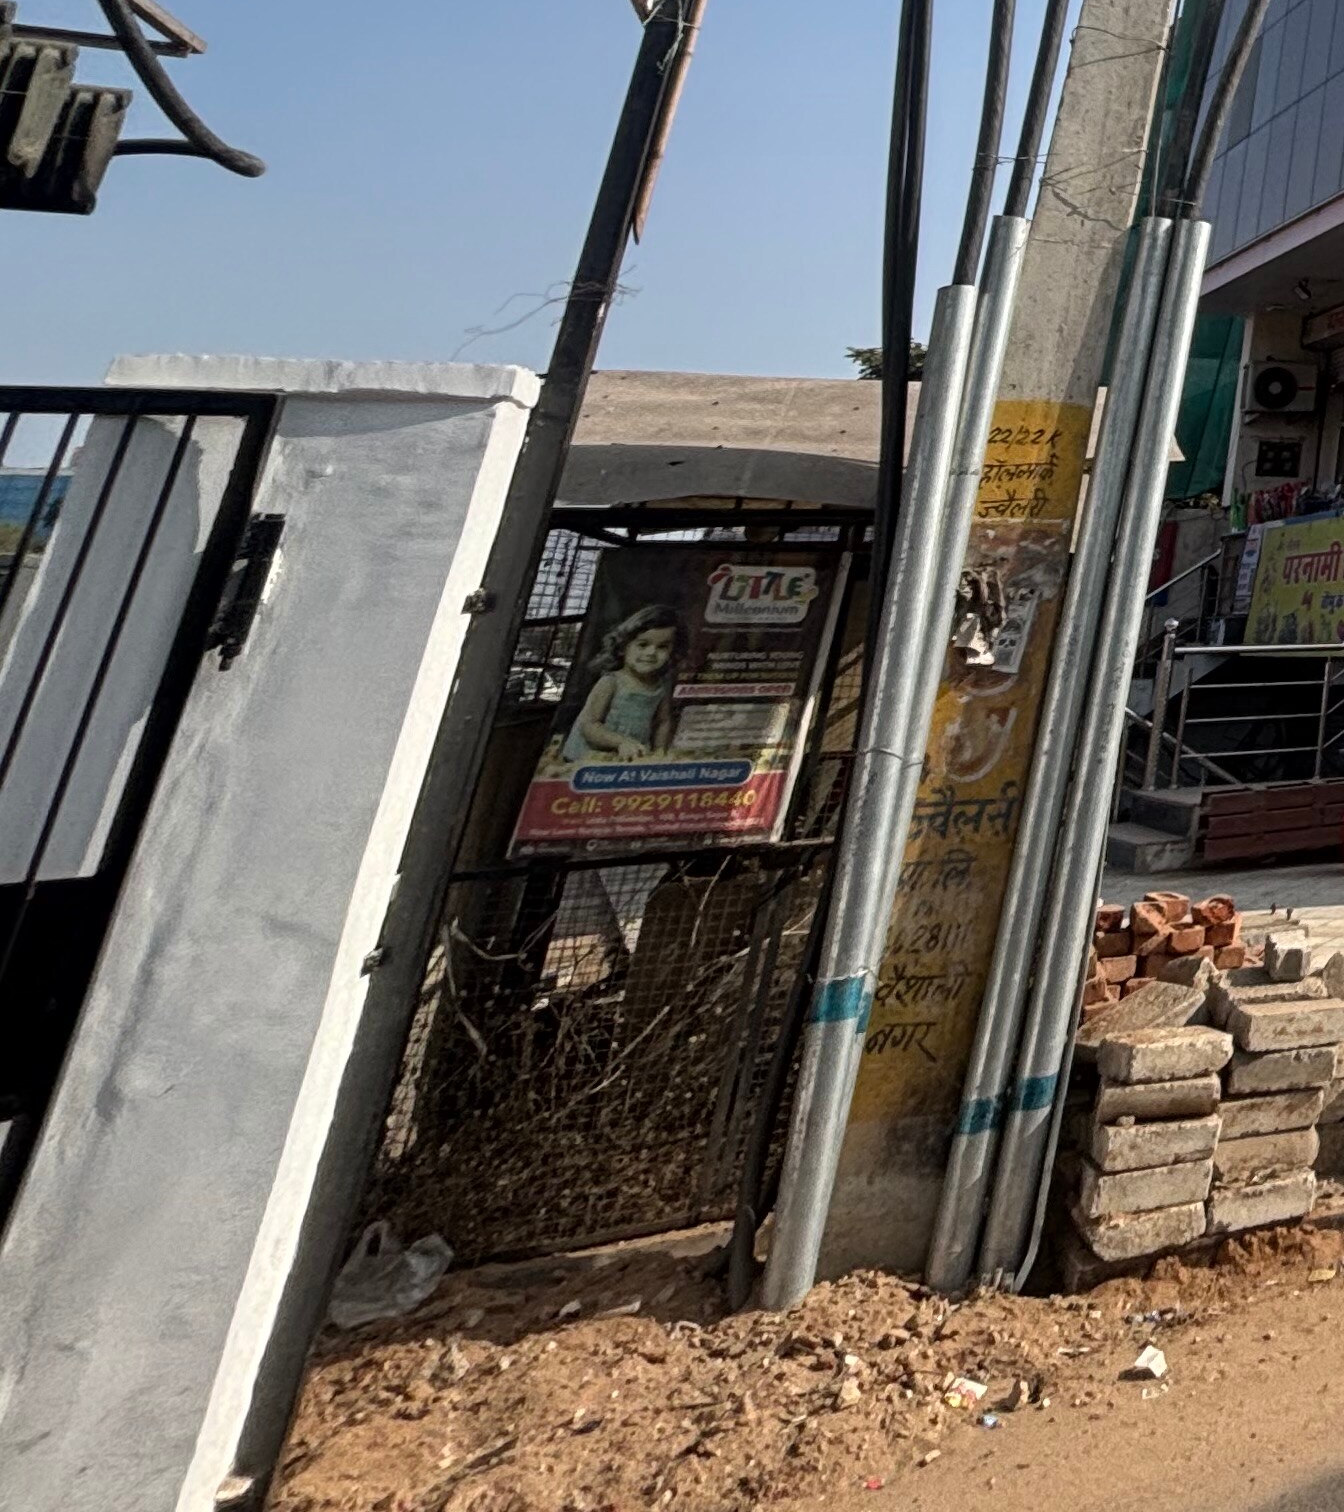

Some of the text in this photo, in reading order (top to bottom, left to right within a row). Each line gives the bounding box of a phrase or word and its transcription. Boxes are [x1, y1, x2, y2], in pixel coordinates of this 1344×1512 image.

[1282, 541, 1342, 585] परनामी
[582, 771, 618, 784] Now
[639, 767, 697, 782] Vaishali
[699, 767, 743, 781] Nagar
[551, 796, 601, 815] Call:
[865, 1022, 938, 1063] नगर
